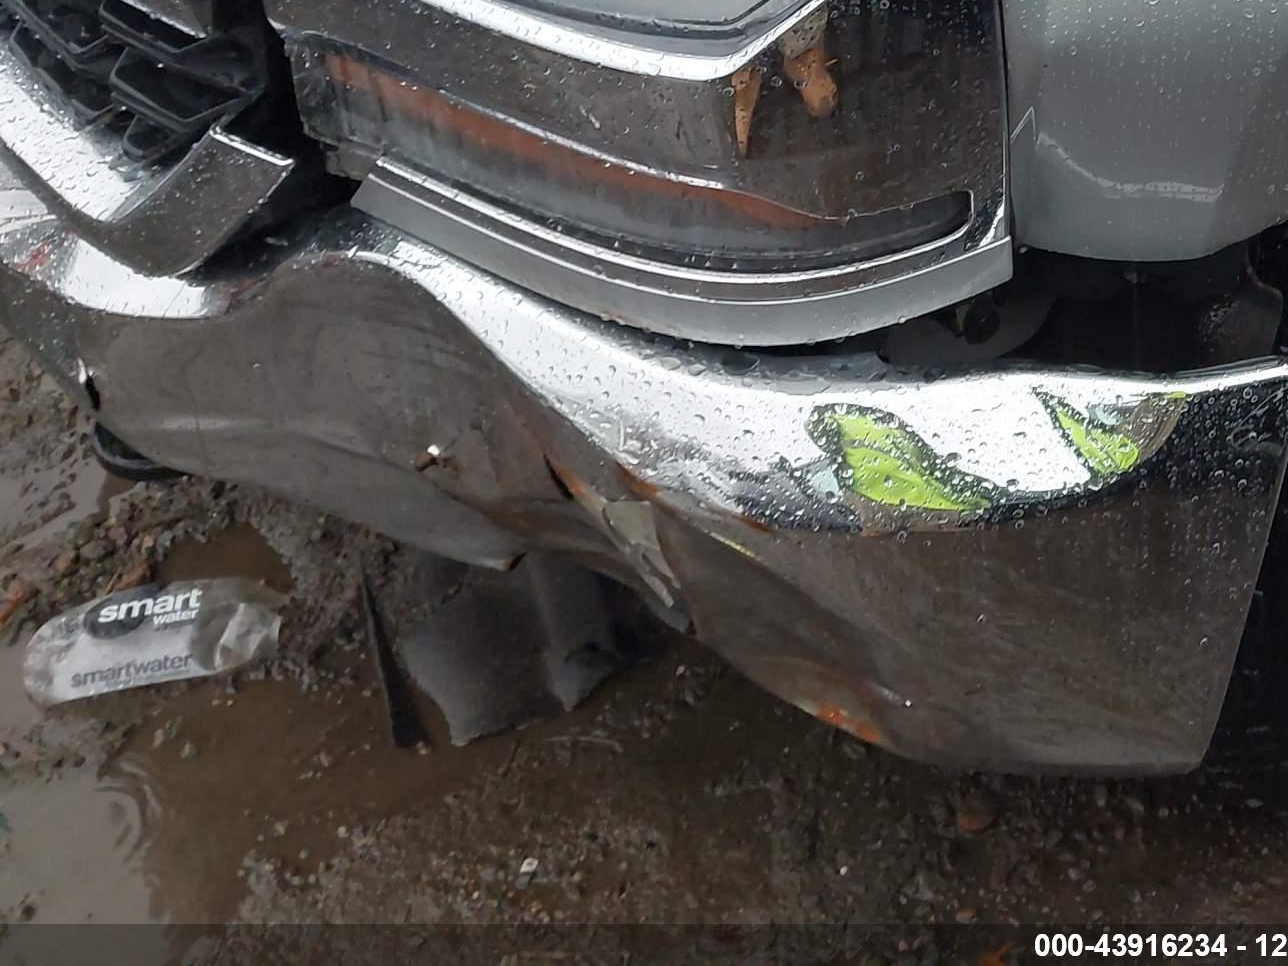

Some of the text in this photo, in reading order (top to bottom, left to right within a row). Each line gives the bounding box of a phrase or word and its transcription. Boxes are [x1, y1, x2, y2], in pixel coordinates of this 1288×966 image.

[98, 588, 202, 624] smart
[152, 608, 200, 626] water
[70, 652, 194, 688] smartwater
